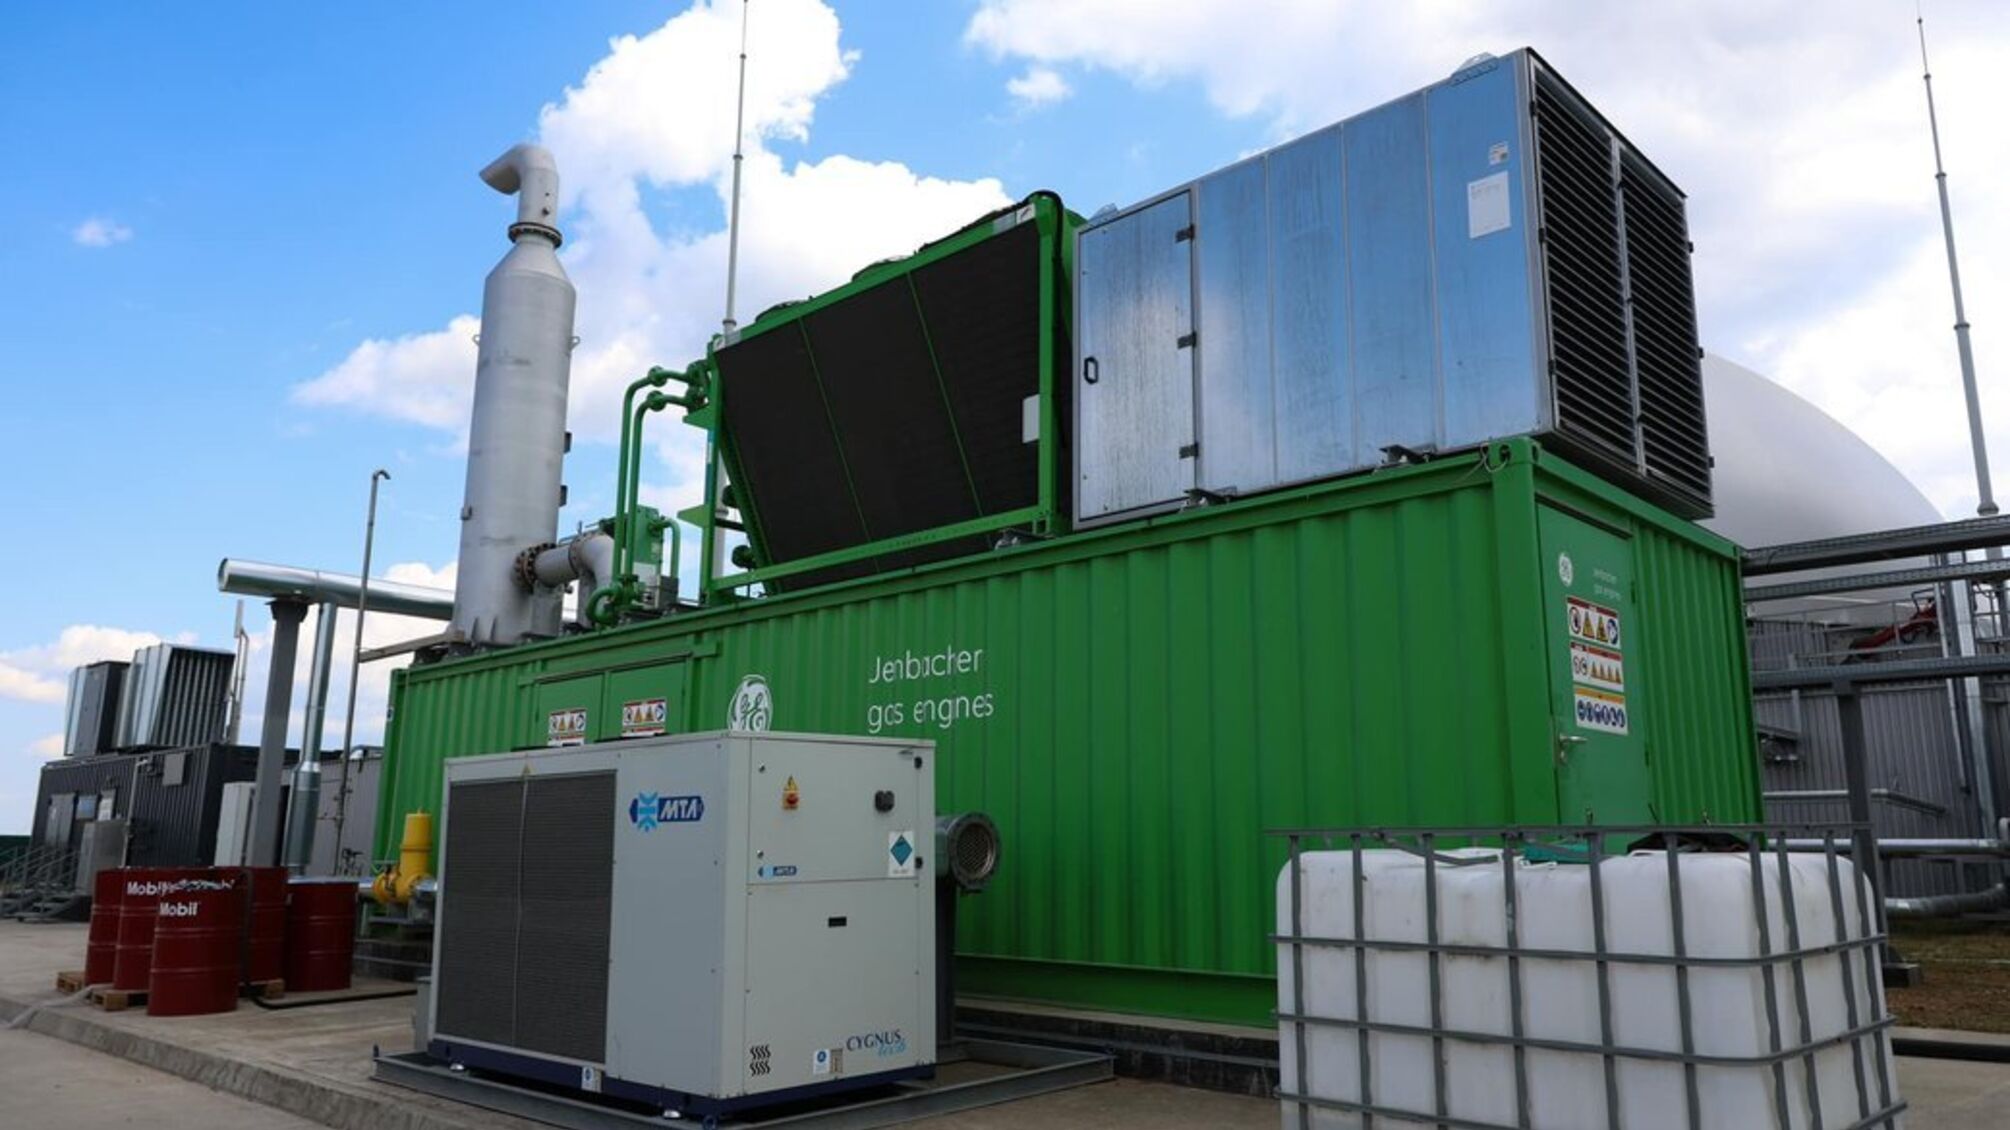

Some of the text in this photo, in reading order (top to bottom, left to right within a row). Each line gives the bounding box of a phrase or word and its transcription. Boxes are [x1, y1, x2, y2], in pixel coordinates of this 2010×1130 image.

[867, 644, 983, 684] Jenbacher
[660, 798, 697, 820] MTA
[126, 881, 162, 896] Mobi
[160, 902, 198, 916] Mobil
[846, 1028, 902, 1052] CYGNUS
